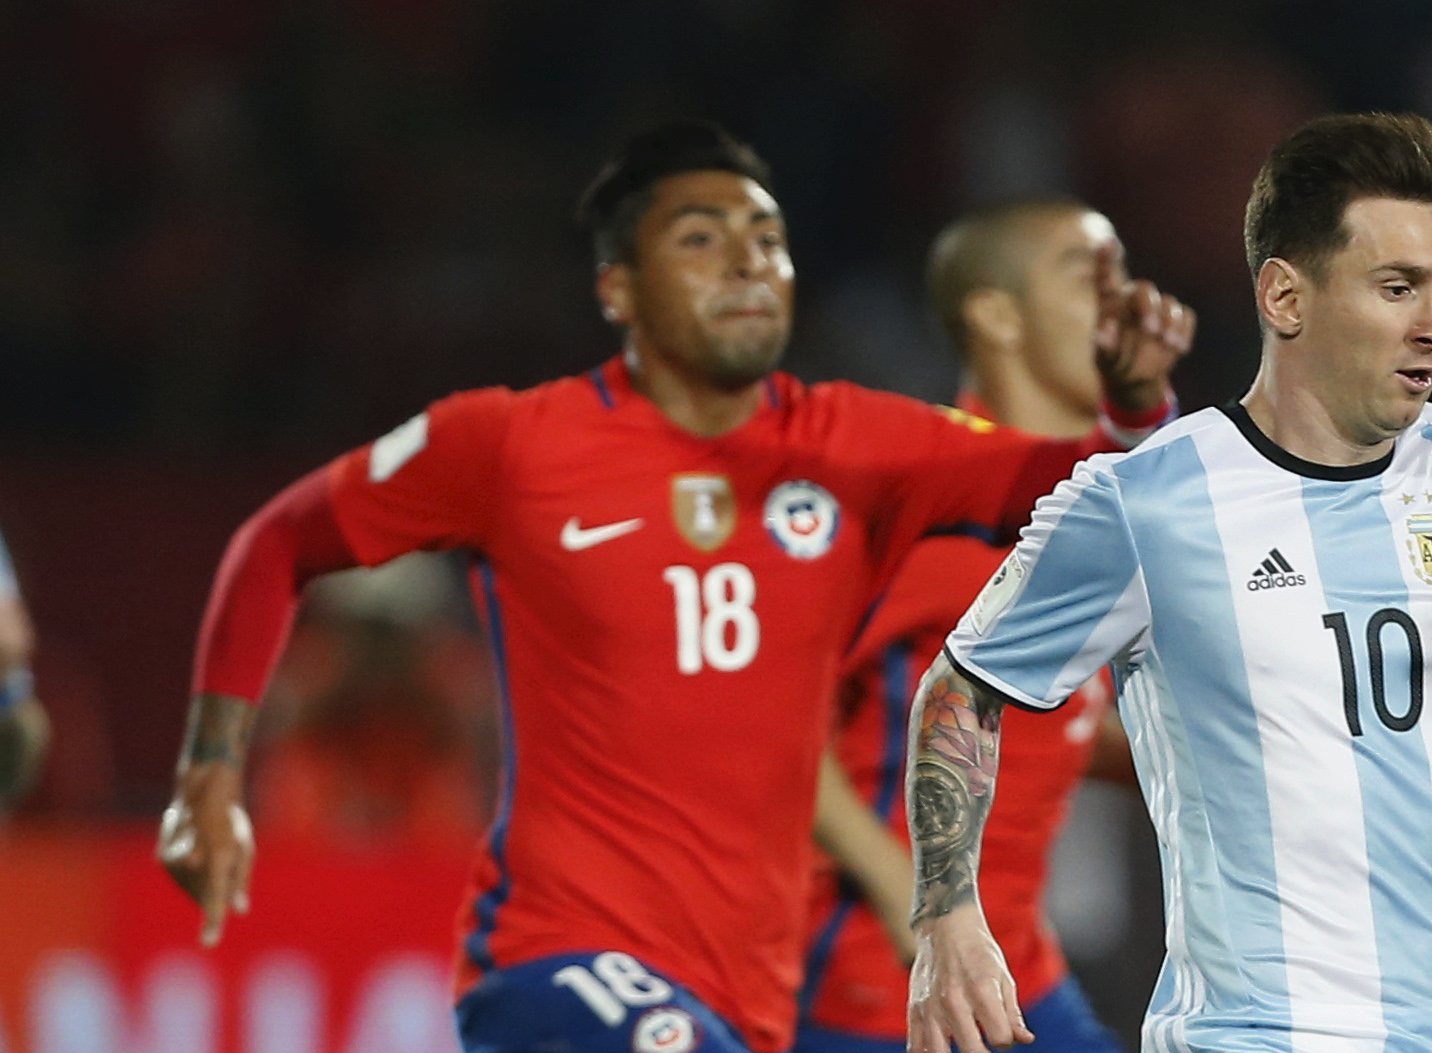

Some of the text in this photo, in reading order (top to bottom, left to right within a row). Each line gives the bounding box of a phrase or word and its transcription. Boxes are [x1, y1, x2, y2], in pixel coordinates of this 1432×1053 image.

[663, 562, 760, 676] 18
[1246, 573, 1306, 591] adidas
[1321, 608, 1424, 737] 10
[552, 951, 673, 1028] 18
